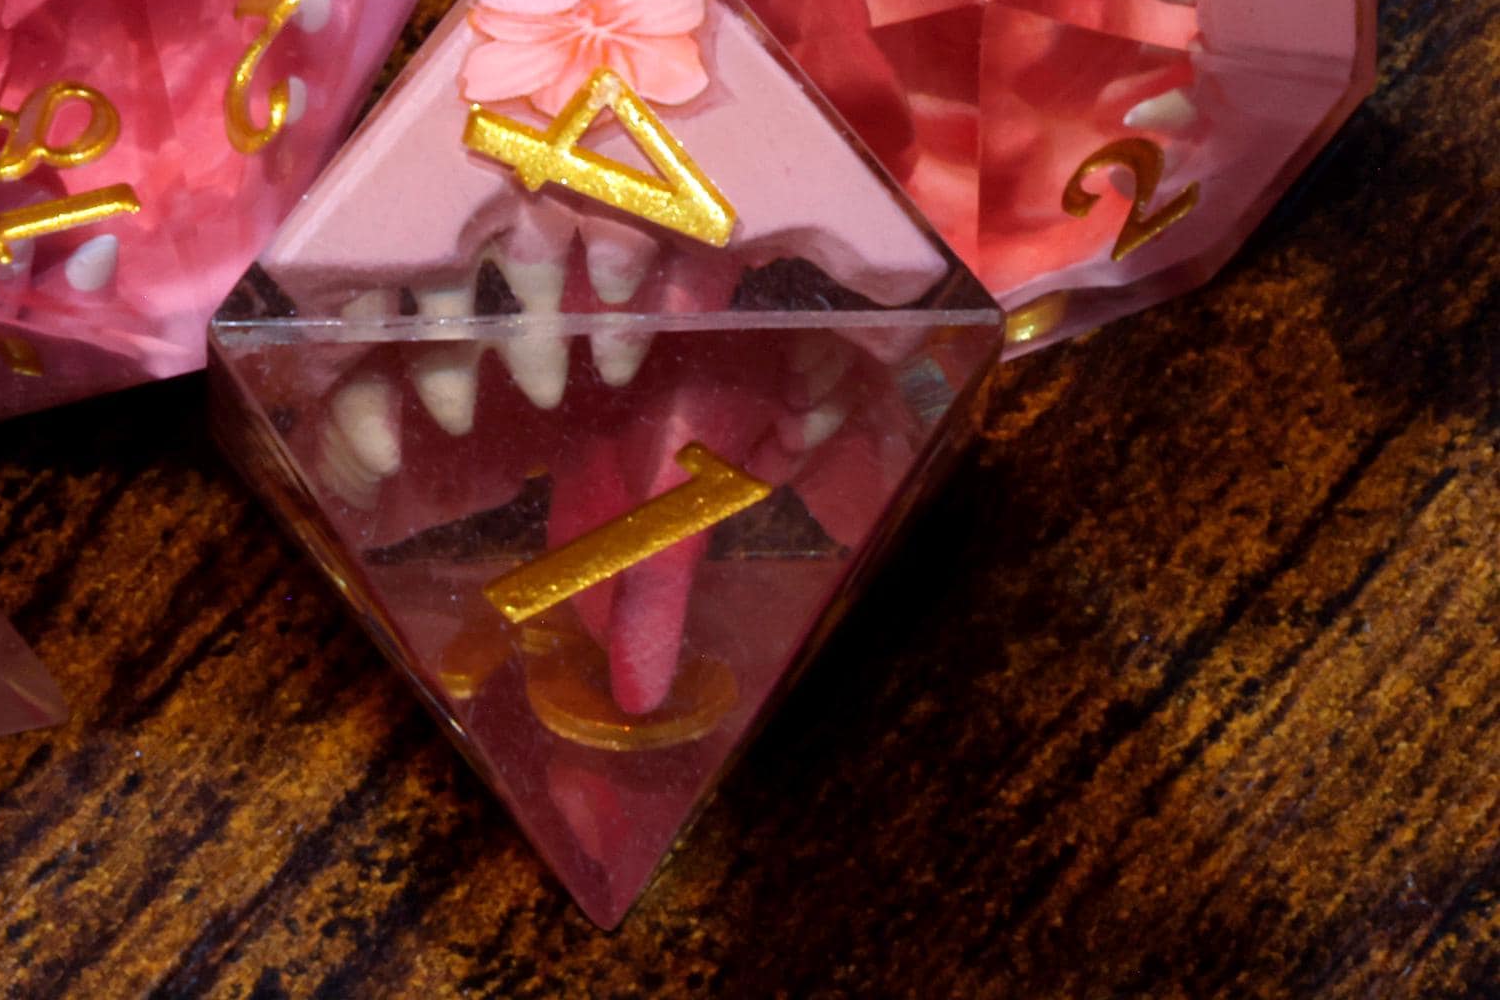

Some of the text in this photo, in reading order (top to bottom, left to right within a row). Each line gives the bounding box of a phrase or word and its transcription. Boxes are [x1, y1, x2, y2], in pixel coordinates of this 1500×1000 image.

[464, 69, 734, 245] 4
[1064, 139, 1197, 259] 2
[485, 443, 769, 621] 1
